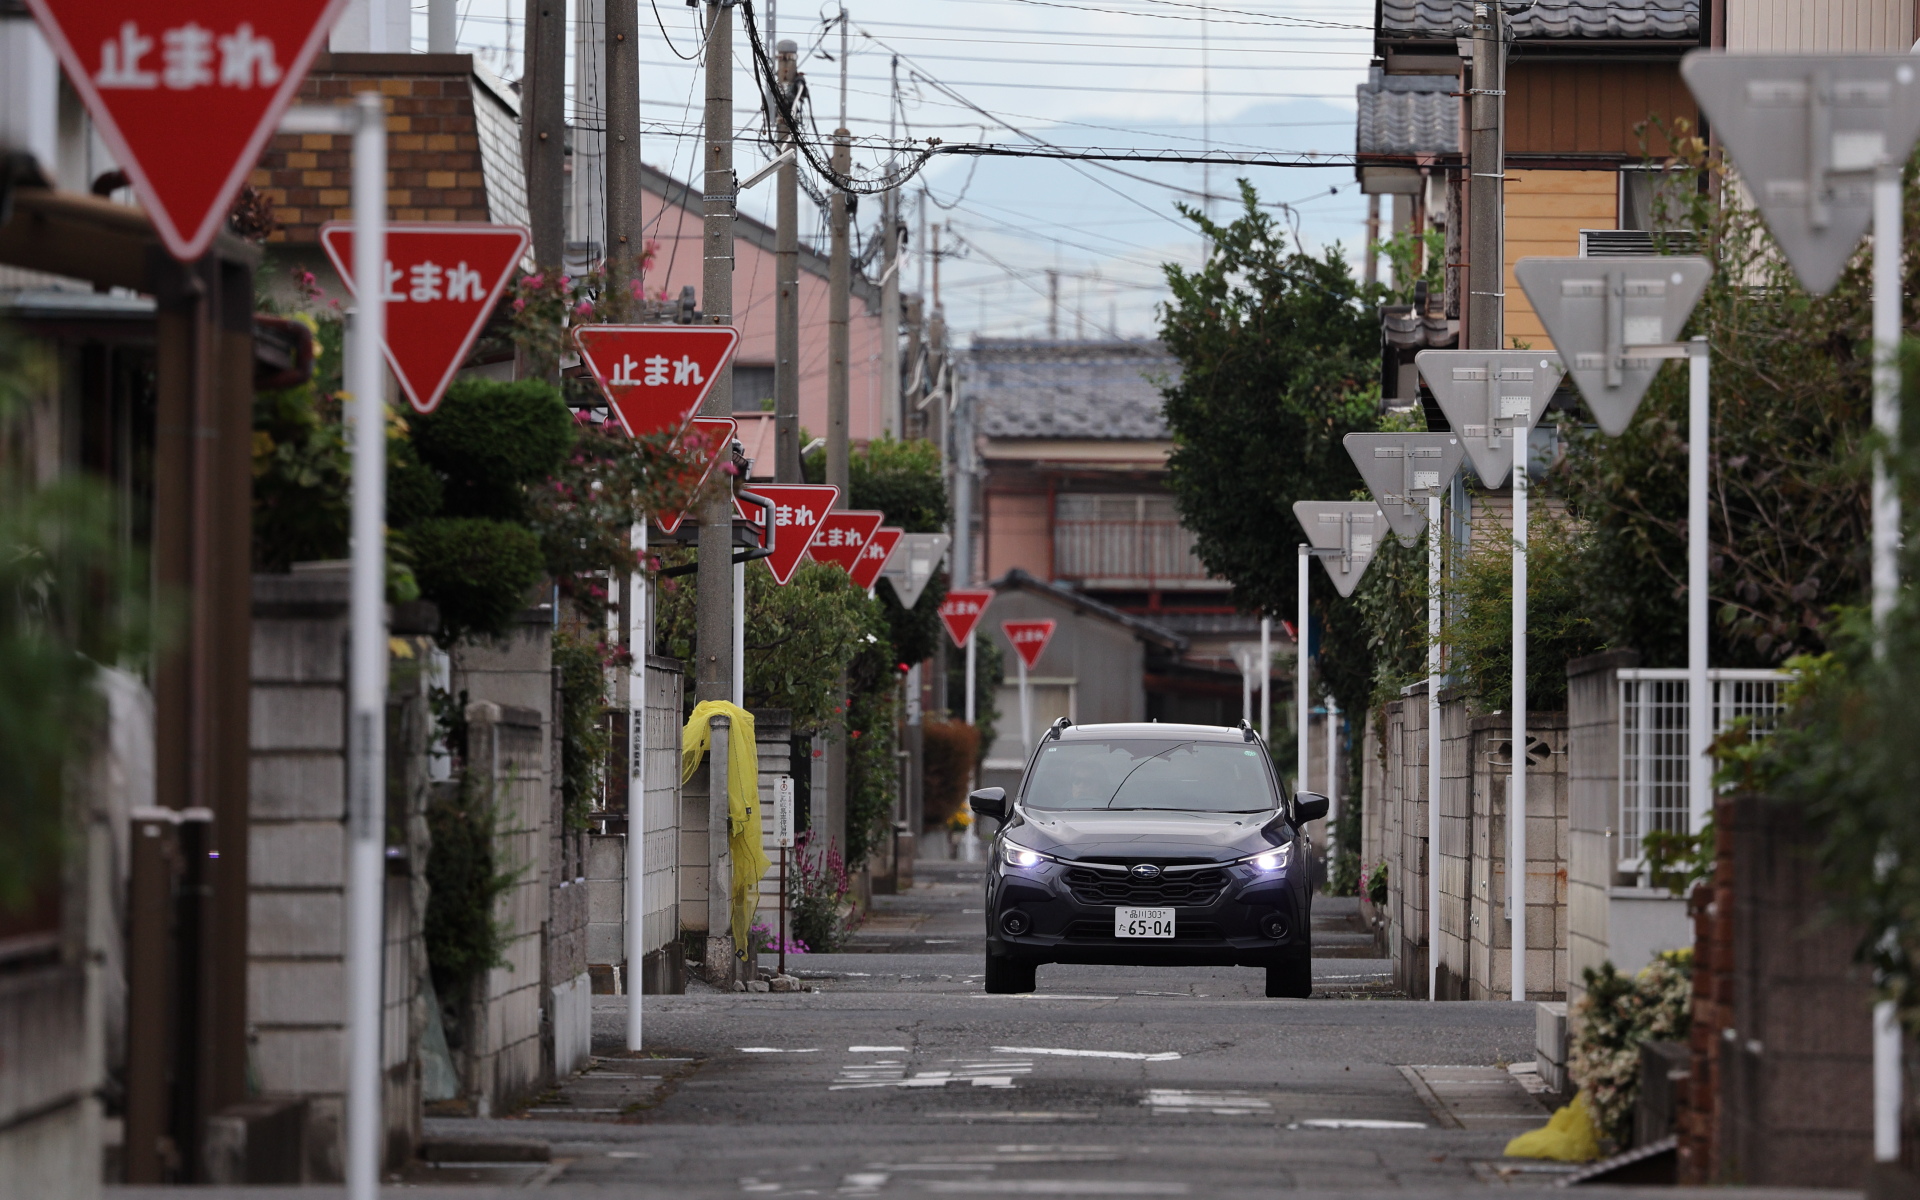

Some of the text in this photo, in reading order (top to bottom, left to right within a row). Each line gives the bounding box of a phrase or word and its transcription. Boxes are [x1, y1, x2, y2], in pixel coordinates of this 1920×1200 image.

[94, 22, 283, 90] 止まれ
[609, 354, 704, 386] 止まれ
[1129, 921, 1171, 935] 65-04
